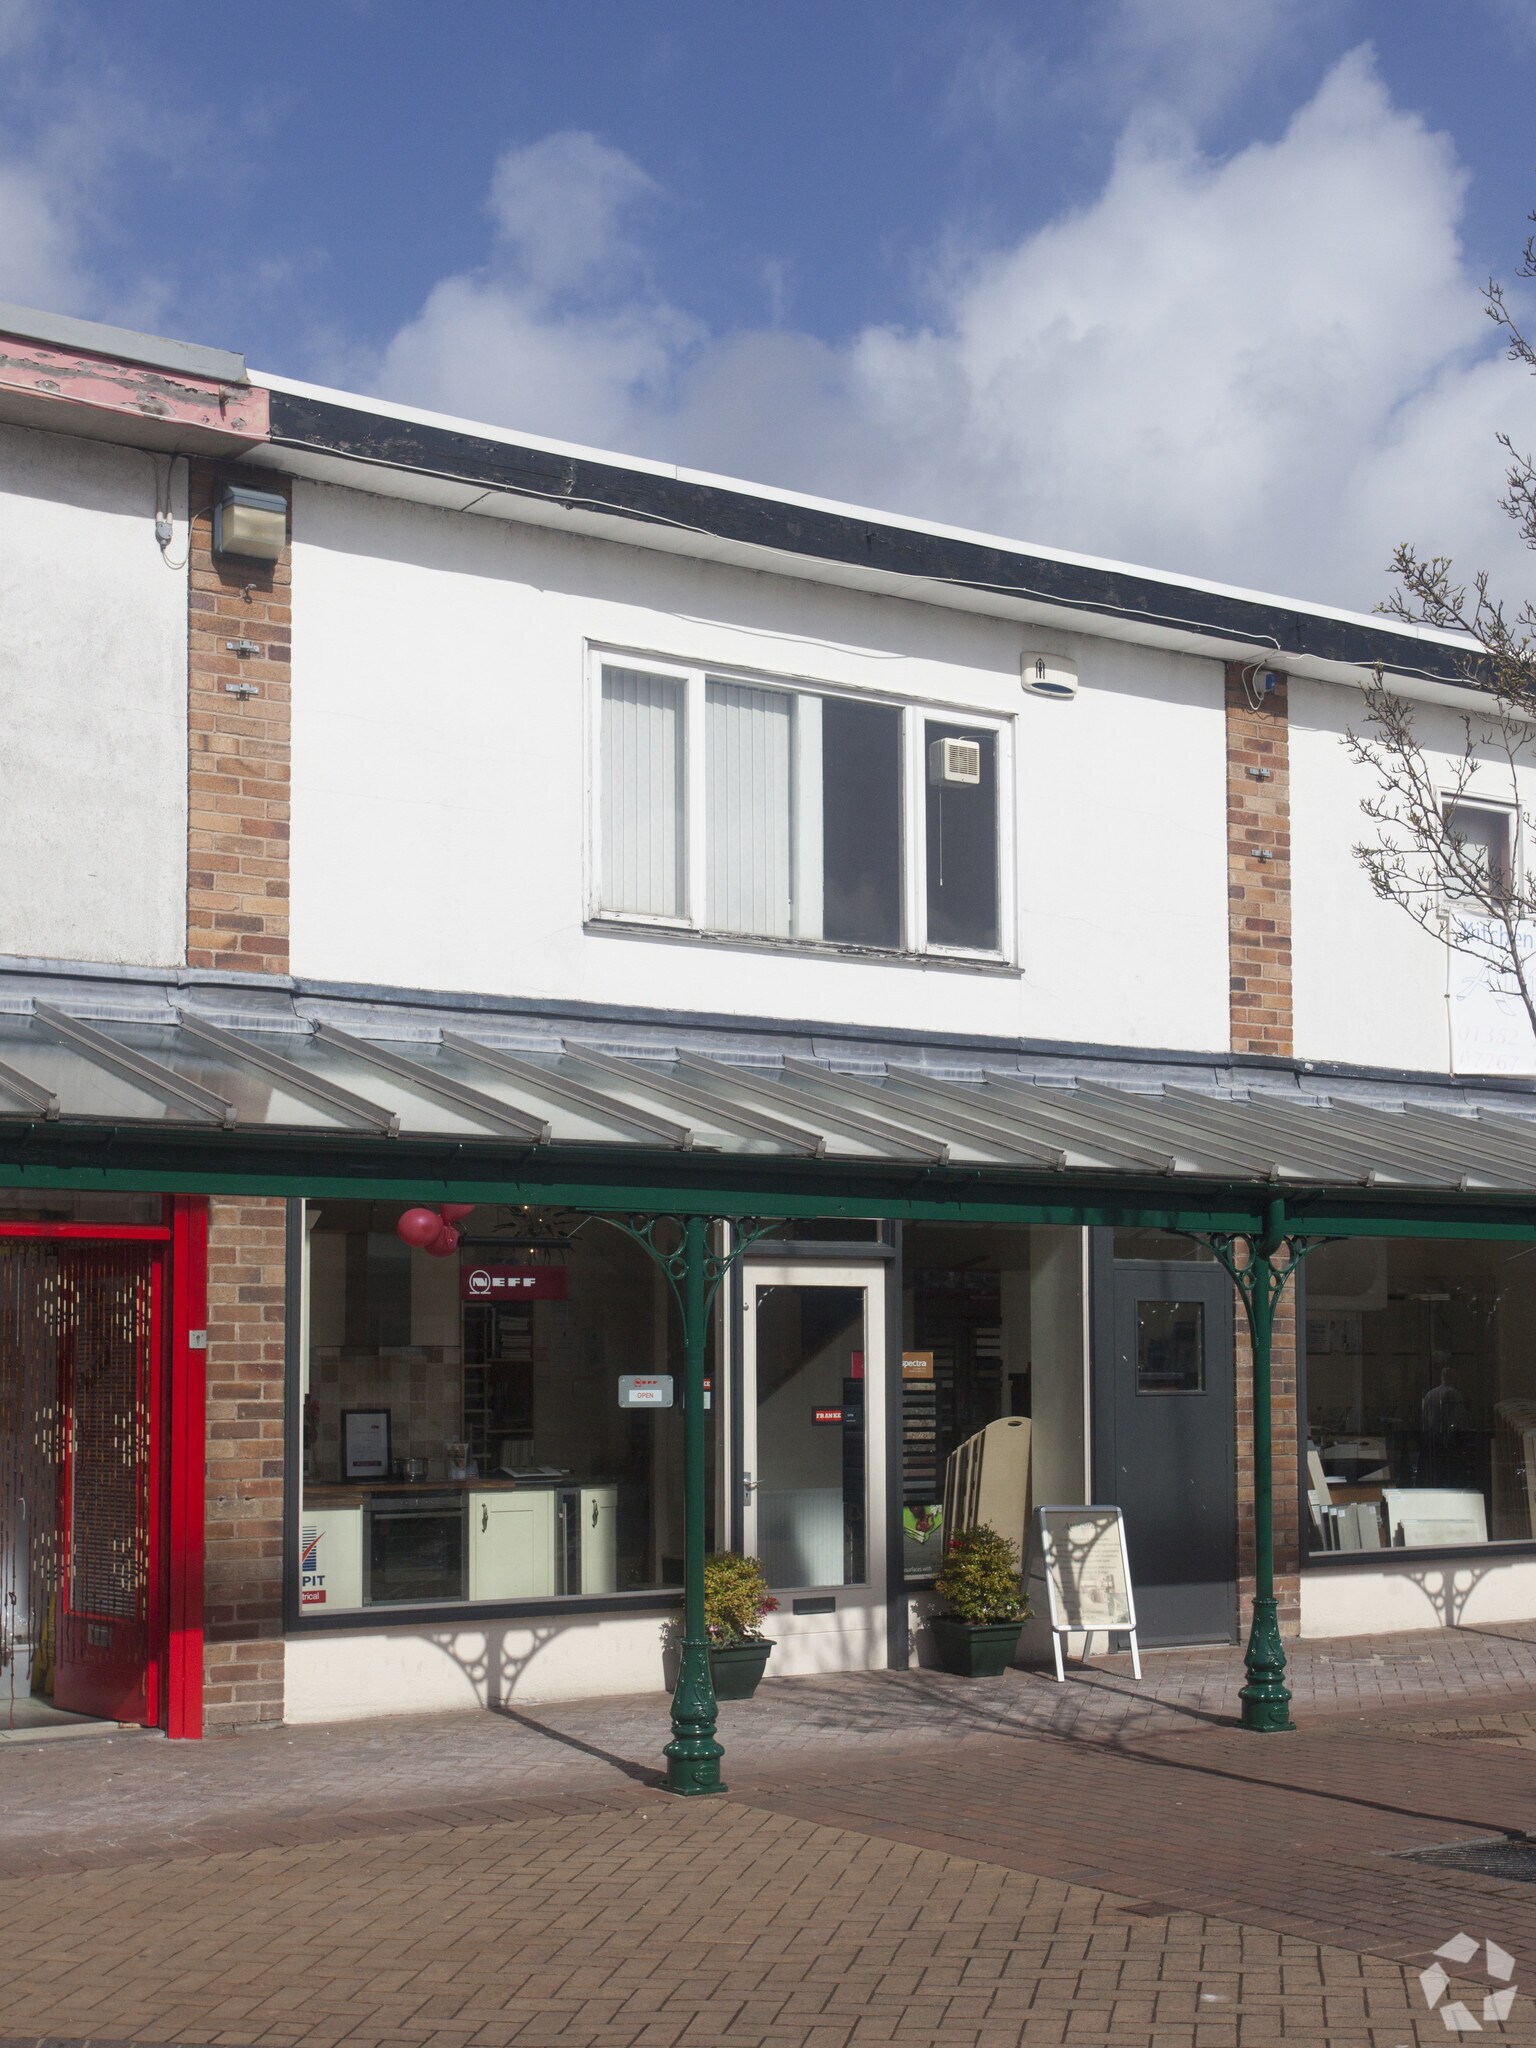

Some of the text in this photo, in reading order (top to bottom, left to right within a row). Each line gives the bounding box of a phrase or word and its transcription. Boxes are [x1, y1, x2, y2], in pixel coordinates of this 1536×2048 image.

[1464, 921, 1533, 948] Kitchen
[471, 1273, 536, 1290] NEFF
[302, 1575, 325, 1586] PIT
